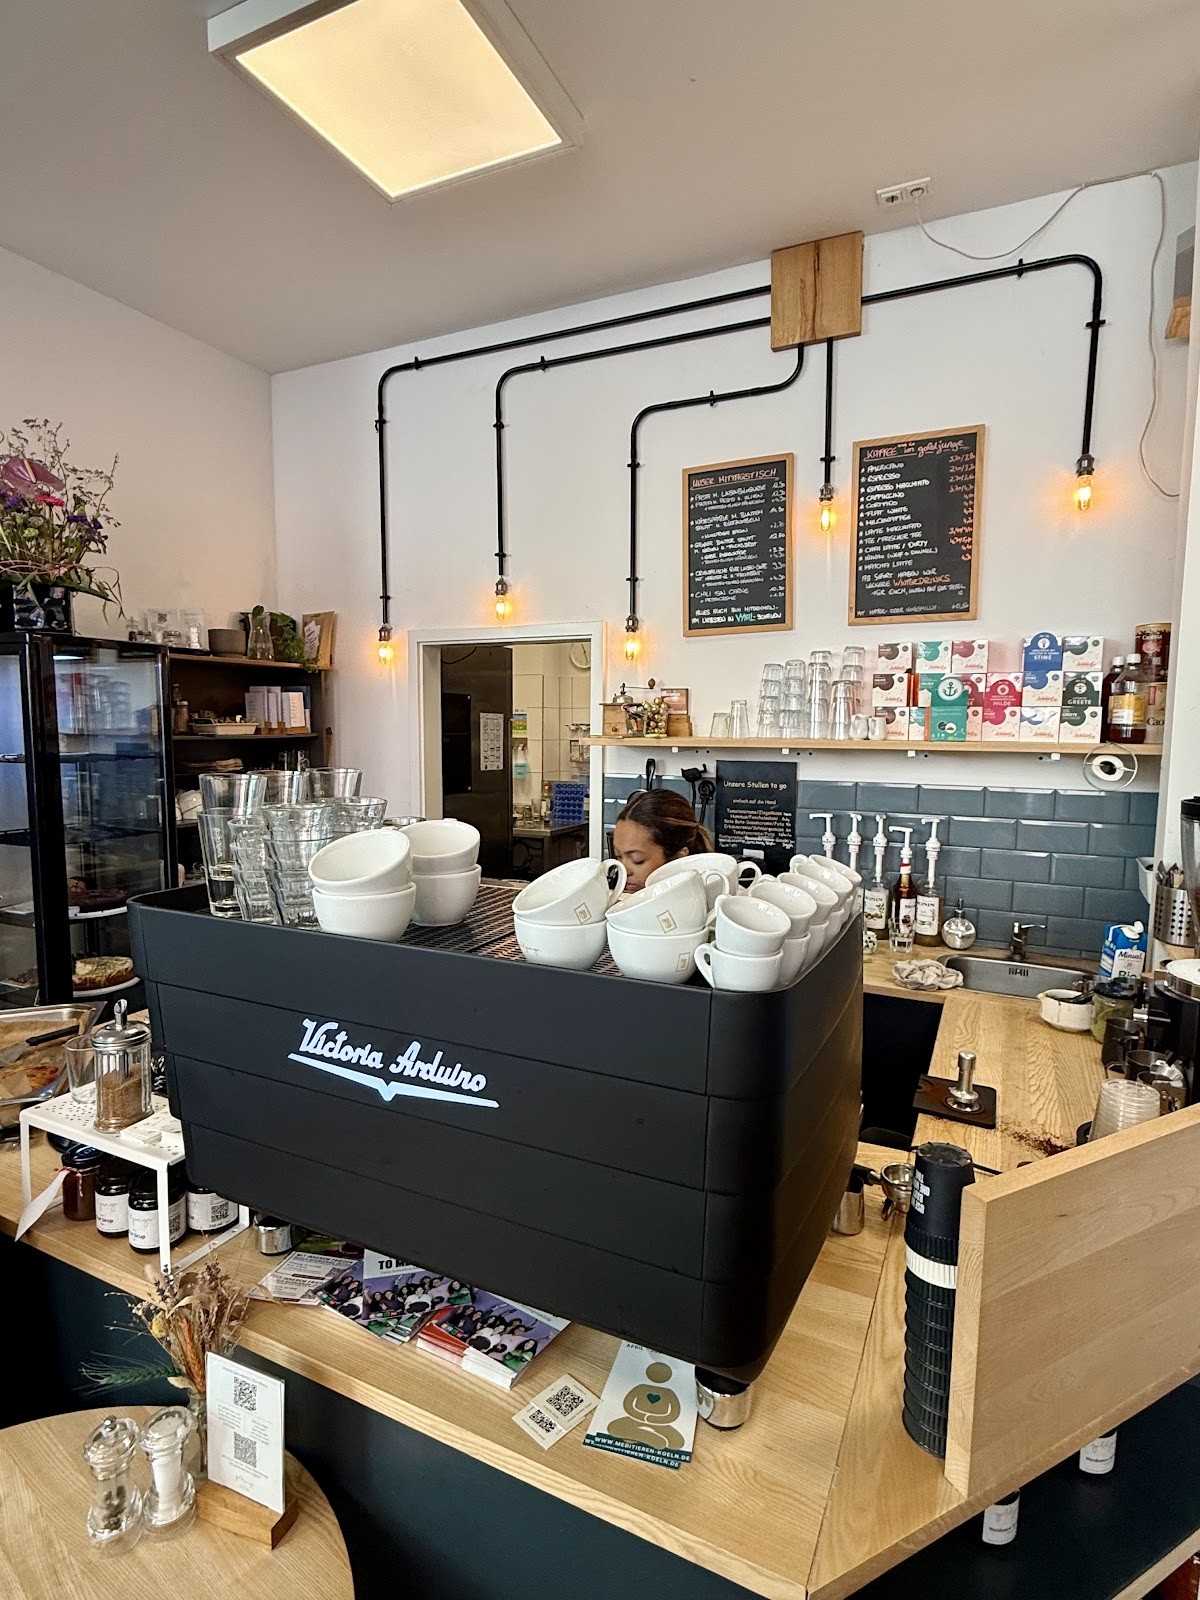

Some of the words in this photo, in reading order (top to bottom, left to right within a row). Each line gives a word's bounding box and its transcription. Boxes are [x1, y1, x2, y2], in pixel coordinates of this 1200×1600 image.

[867, 447, 898, 459] KAFFEE
[918, 440, 964, 457] goldjunge
[867, 463, 904, 473] AMERICANO
[719, 468, 776, 484] MITTAGSTISCH
[867, 473, 900, 482] ESPRESSO
[867, 485, 894, 493] ESPRESSO
[896, 479, 930, 490] MACCHIATO
[866, 492, 905, 501] CAPPUCCINO
[866, 501, 898, 509] CORTADO
[887, 506, 909, 514] WHITE
[908, 540, 928, 549] DIRTY
[864, 563, 890, 571] MATCHA
[892, 560, 913, 568] LATTE
[898, 570, 919, 578] HABEN
[893, 574, 951, 587] WINTERDRINKS
[299, 1018, 384, 1069] Victoria
[389, 1041, 487, 1092] Arduino
[378, 1260, 393, 1270] TO
[595, 1436, 690, 1461] WWW.MEDITIEREN-KOELN.DE
